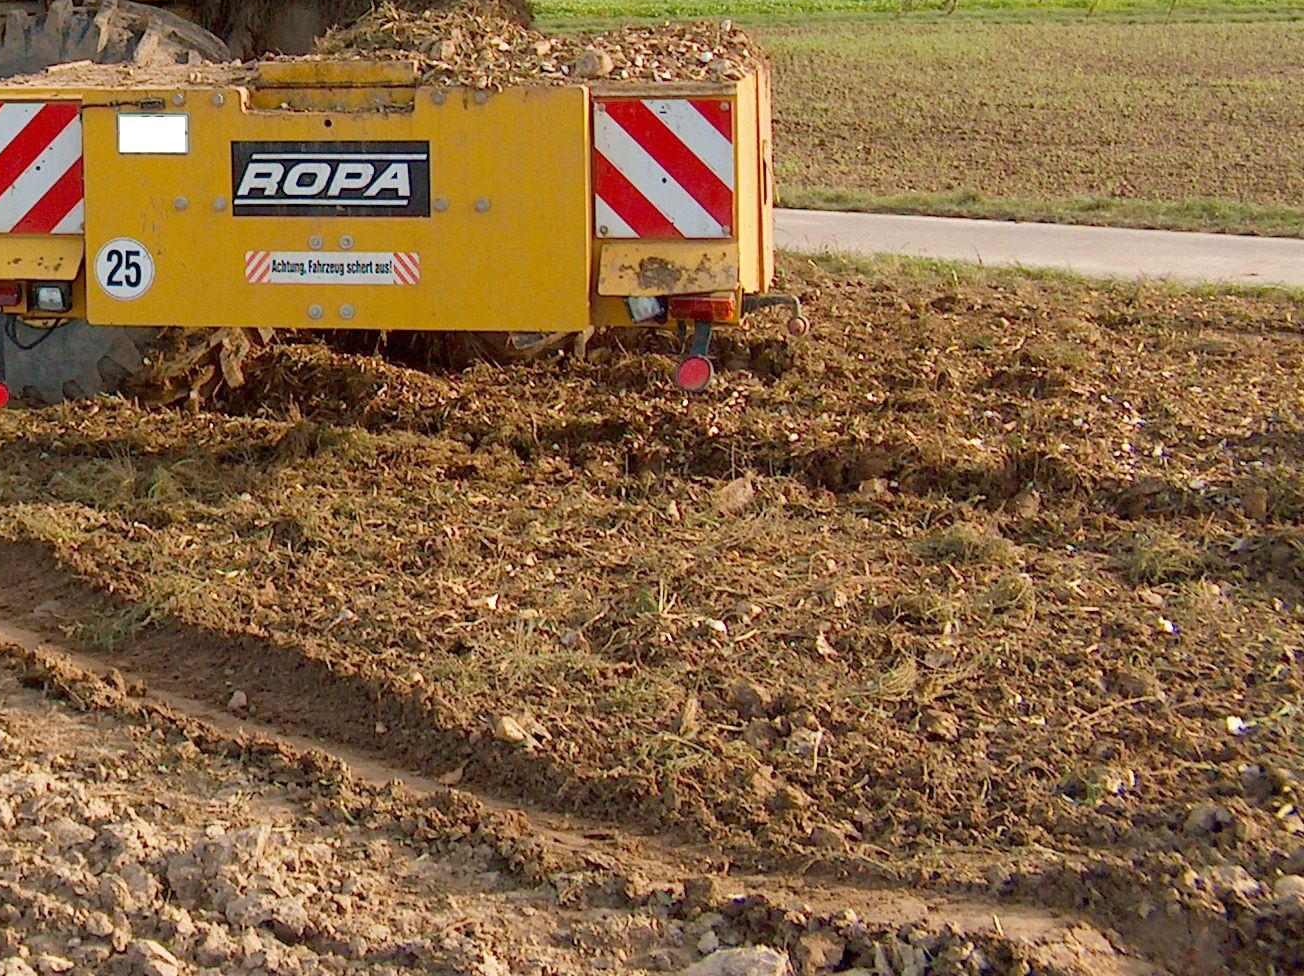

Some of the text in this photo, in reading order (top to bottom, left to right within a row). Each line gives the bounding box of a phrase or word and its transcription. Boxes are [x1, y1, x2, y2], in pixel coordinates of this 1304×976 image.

[236, 162, 411, 197] ROPA
[106, 249, 142, 288] 25
[271, 259, 393, 276] Achtung, Fahrzeug schert aus!
